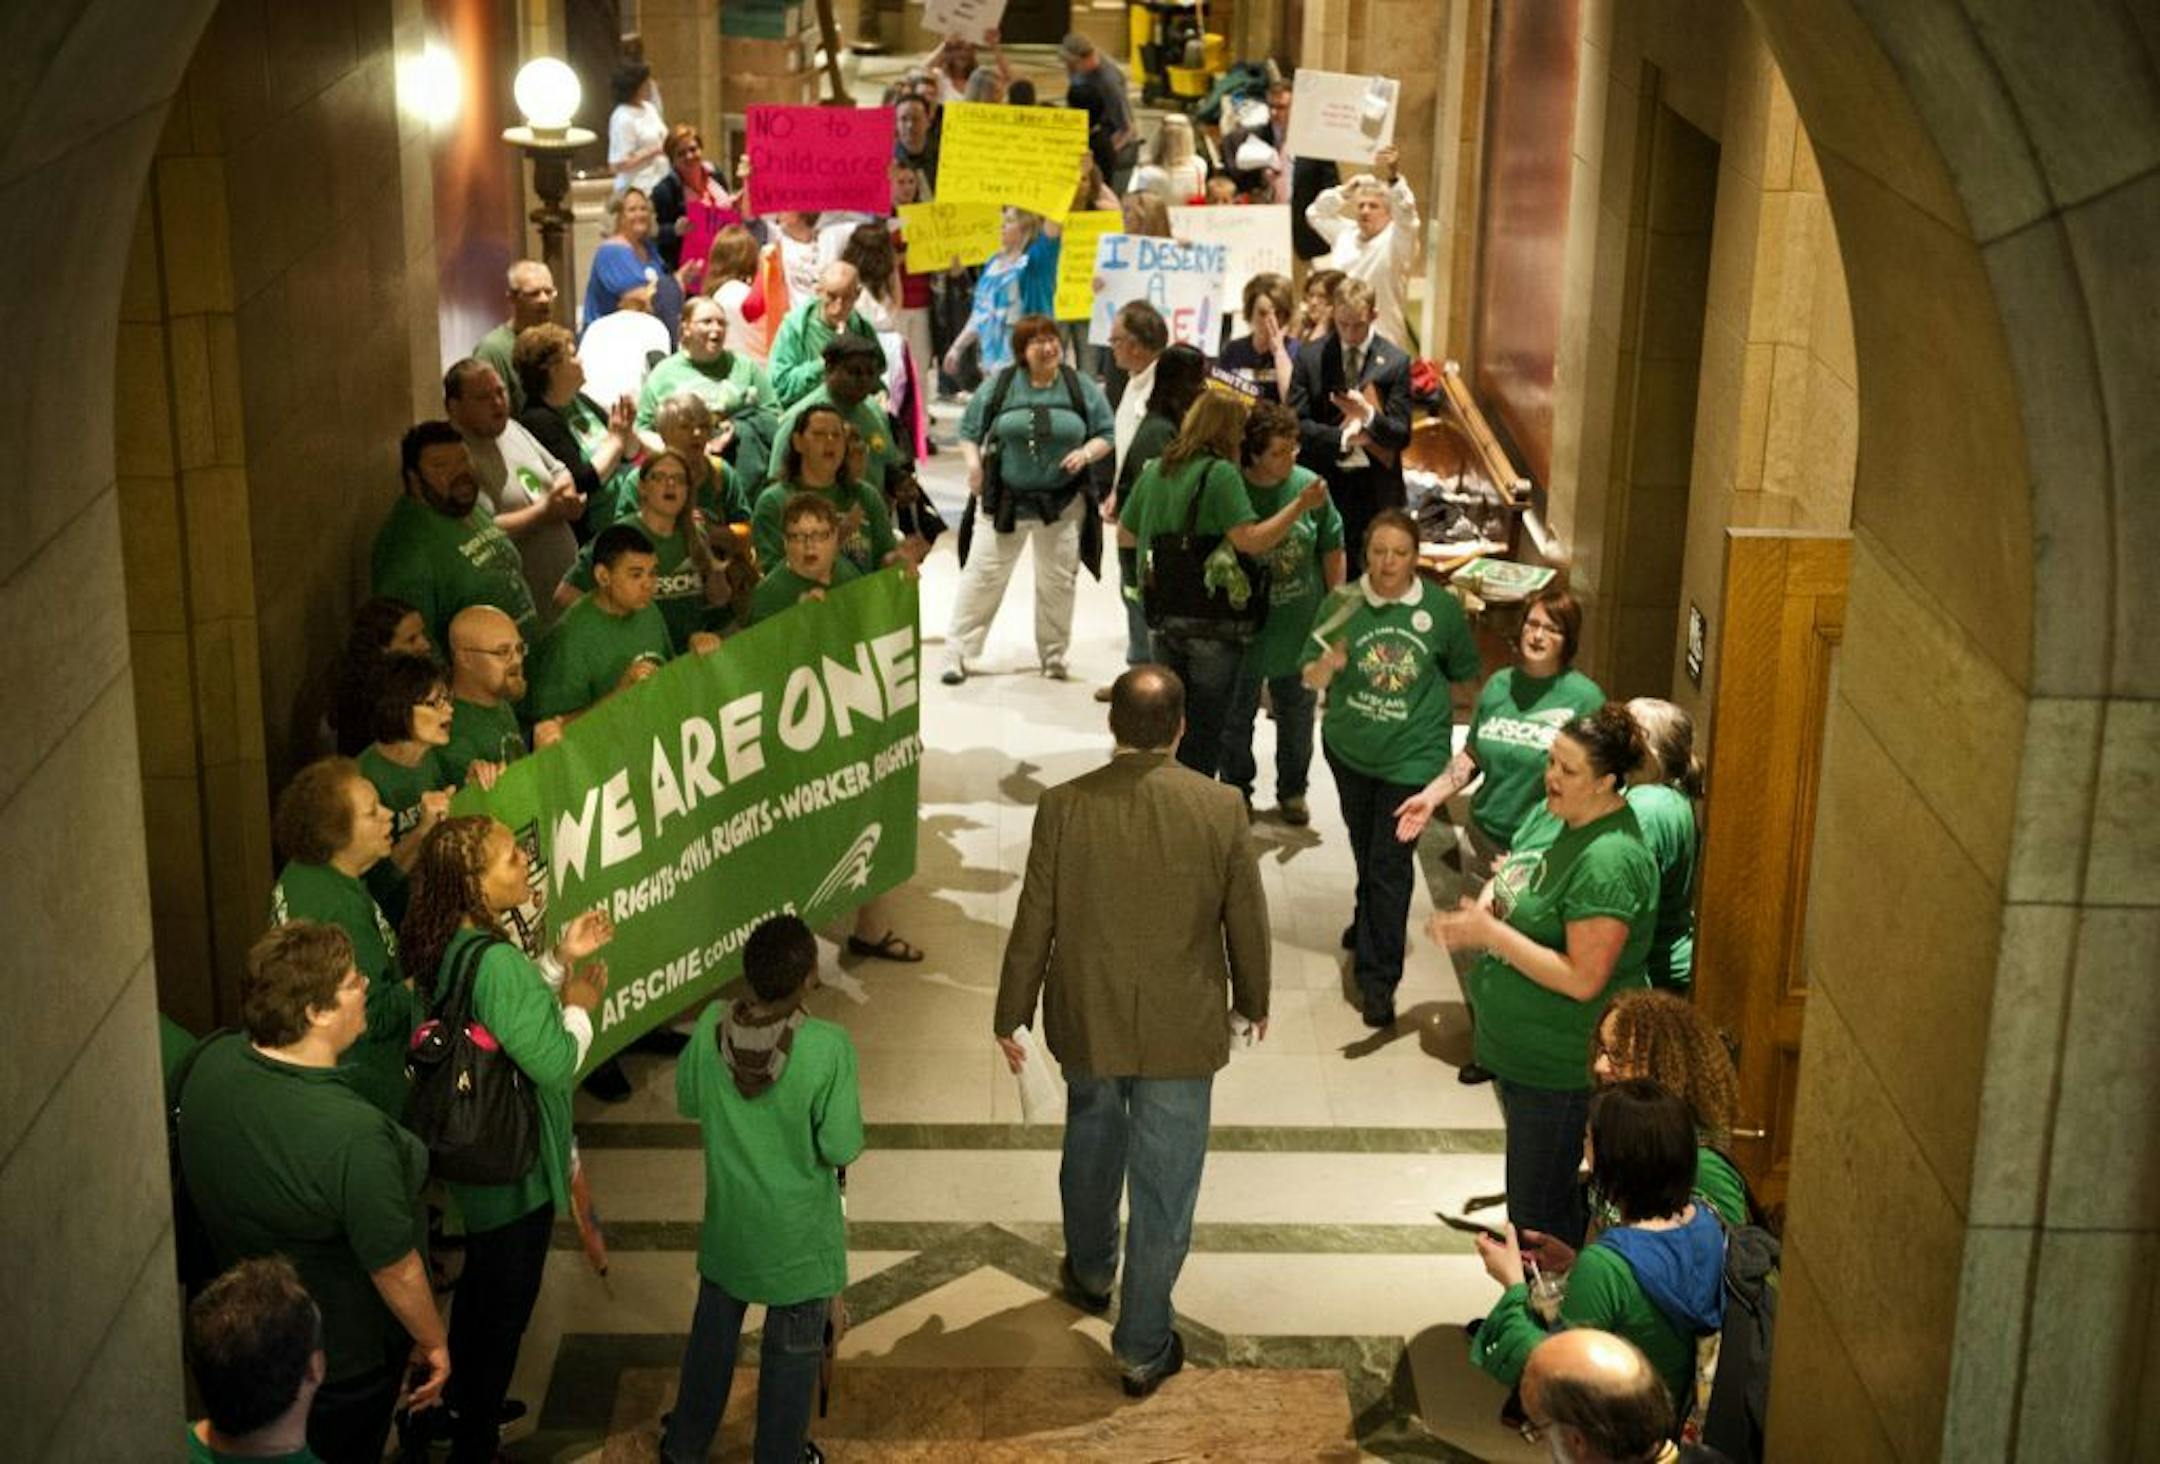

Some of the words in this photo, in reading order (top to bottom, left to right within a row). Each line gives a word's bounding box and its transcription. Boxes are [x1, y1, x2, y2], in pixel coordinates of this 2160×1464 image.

[756, 111, 793, 138] NO
[824, 114, 850, 137] to
[1101, 237, 1128, 270] I
[1137, 239, 1225, 273] DESERVE
[1149, 273, 1165, 305] A
[552, 767, 642, 899] WE
[651, 692, 766, 839] ARE
[778, 625, 918, 752] ONE
[613, 864, 676, 924] RIGHTS
[680, 834, 712, 881] CIVIL
[711, 798, 774, 860] RIGHTS
[780, 761, 872, 821] WORKER
[601, 947, 702, 1032] AFSCME
